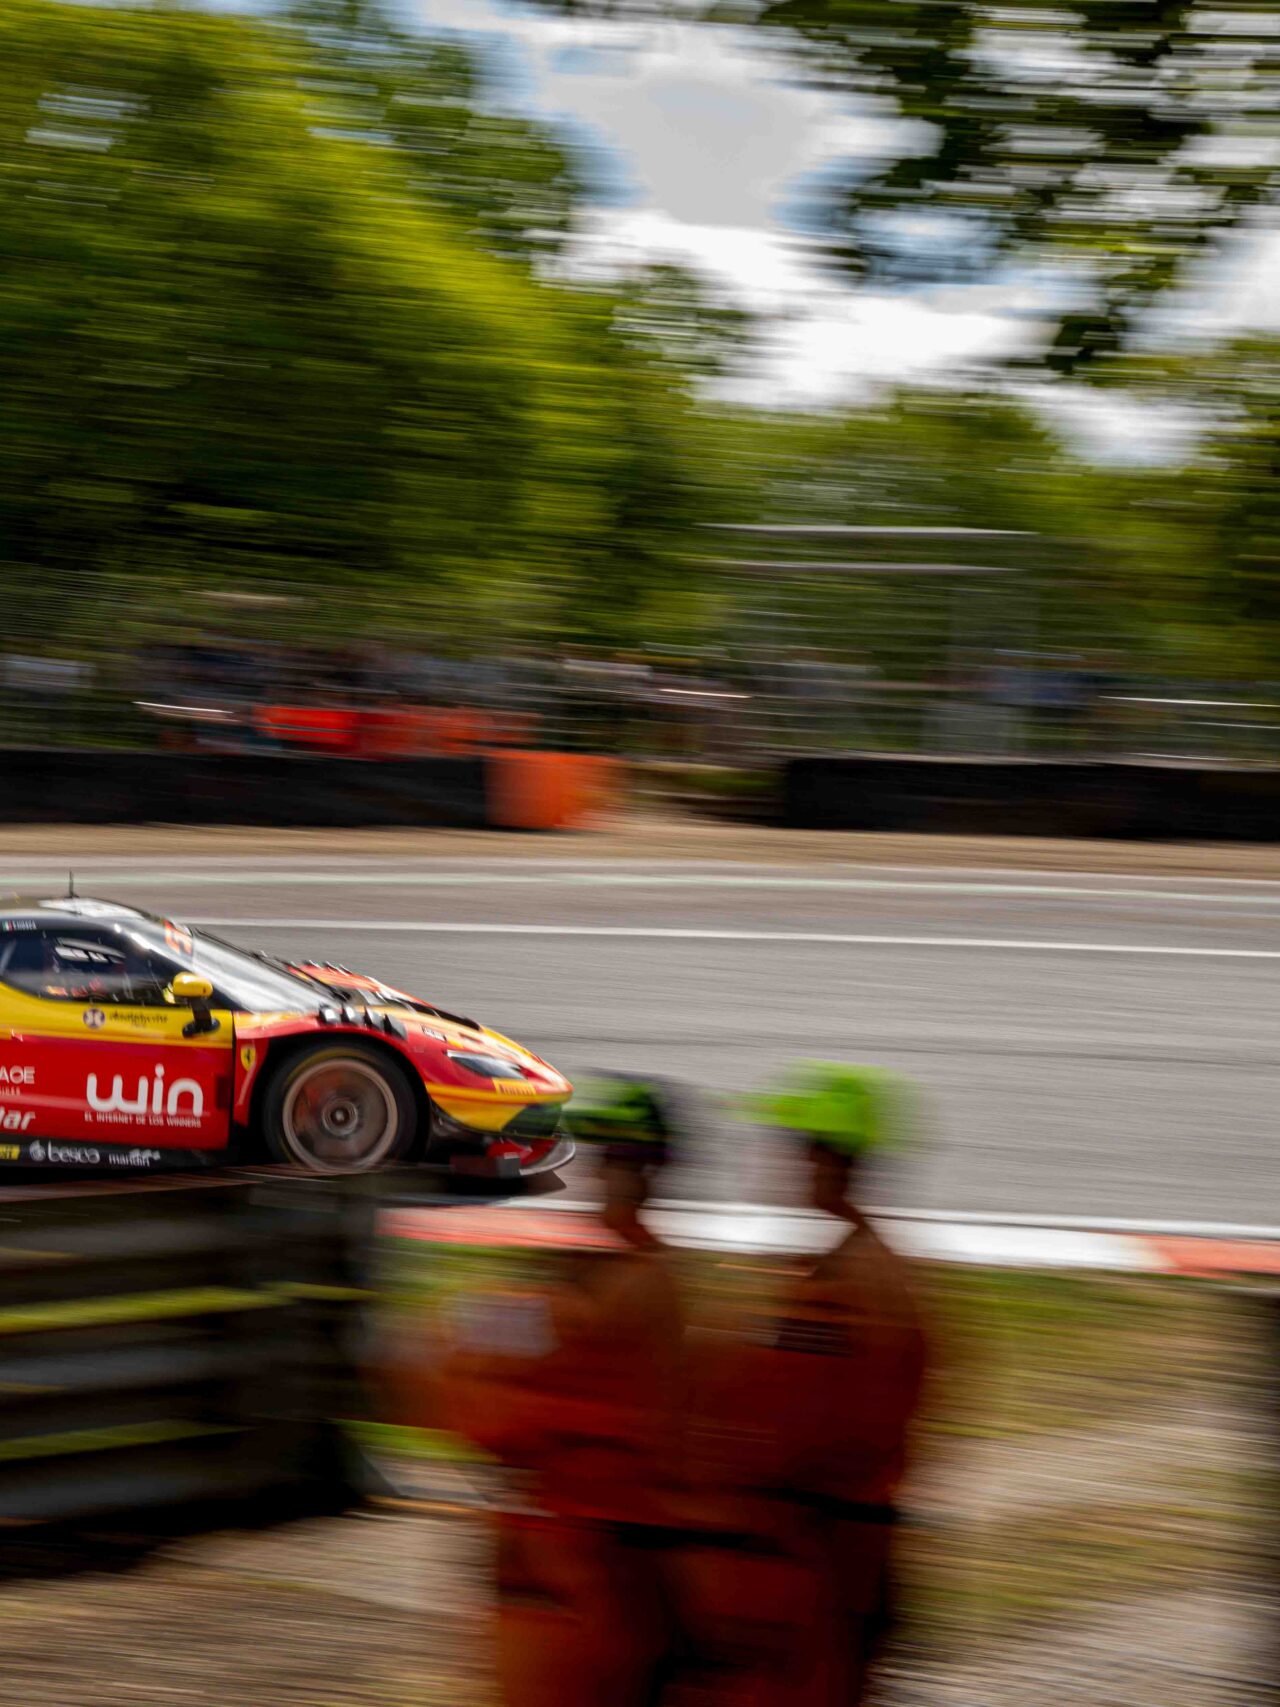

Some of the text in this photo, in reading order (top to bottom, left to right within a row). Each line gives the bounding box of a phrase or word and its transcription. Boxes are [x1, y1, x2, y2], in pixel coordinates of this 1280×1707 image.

[86, 1063, 204, 1118] win
[96, 1112, 133, 1125] INTERNET
[149, 1115, 164, 1127] LOS
[167, 1116, 202, 1129] WINNERS
